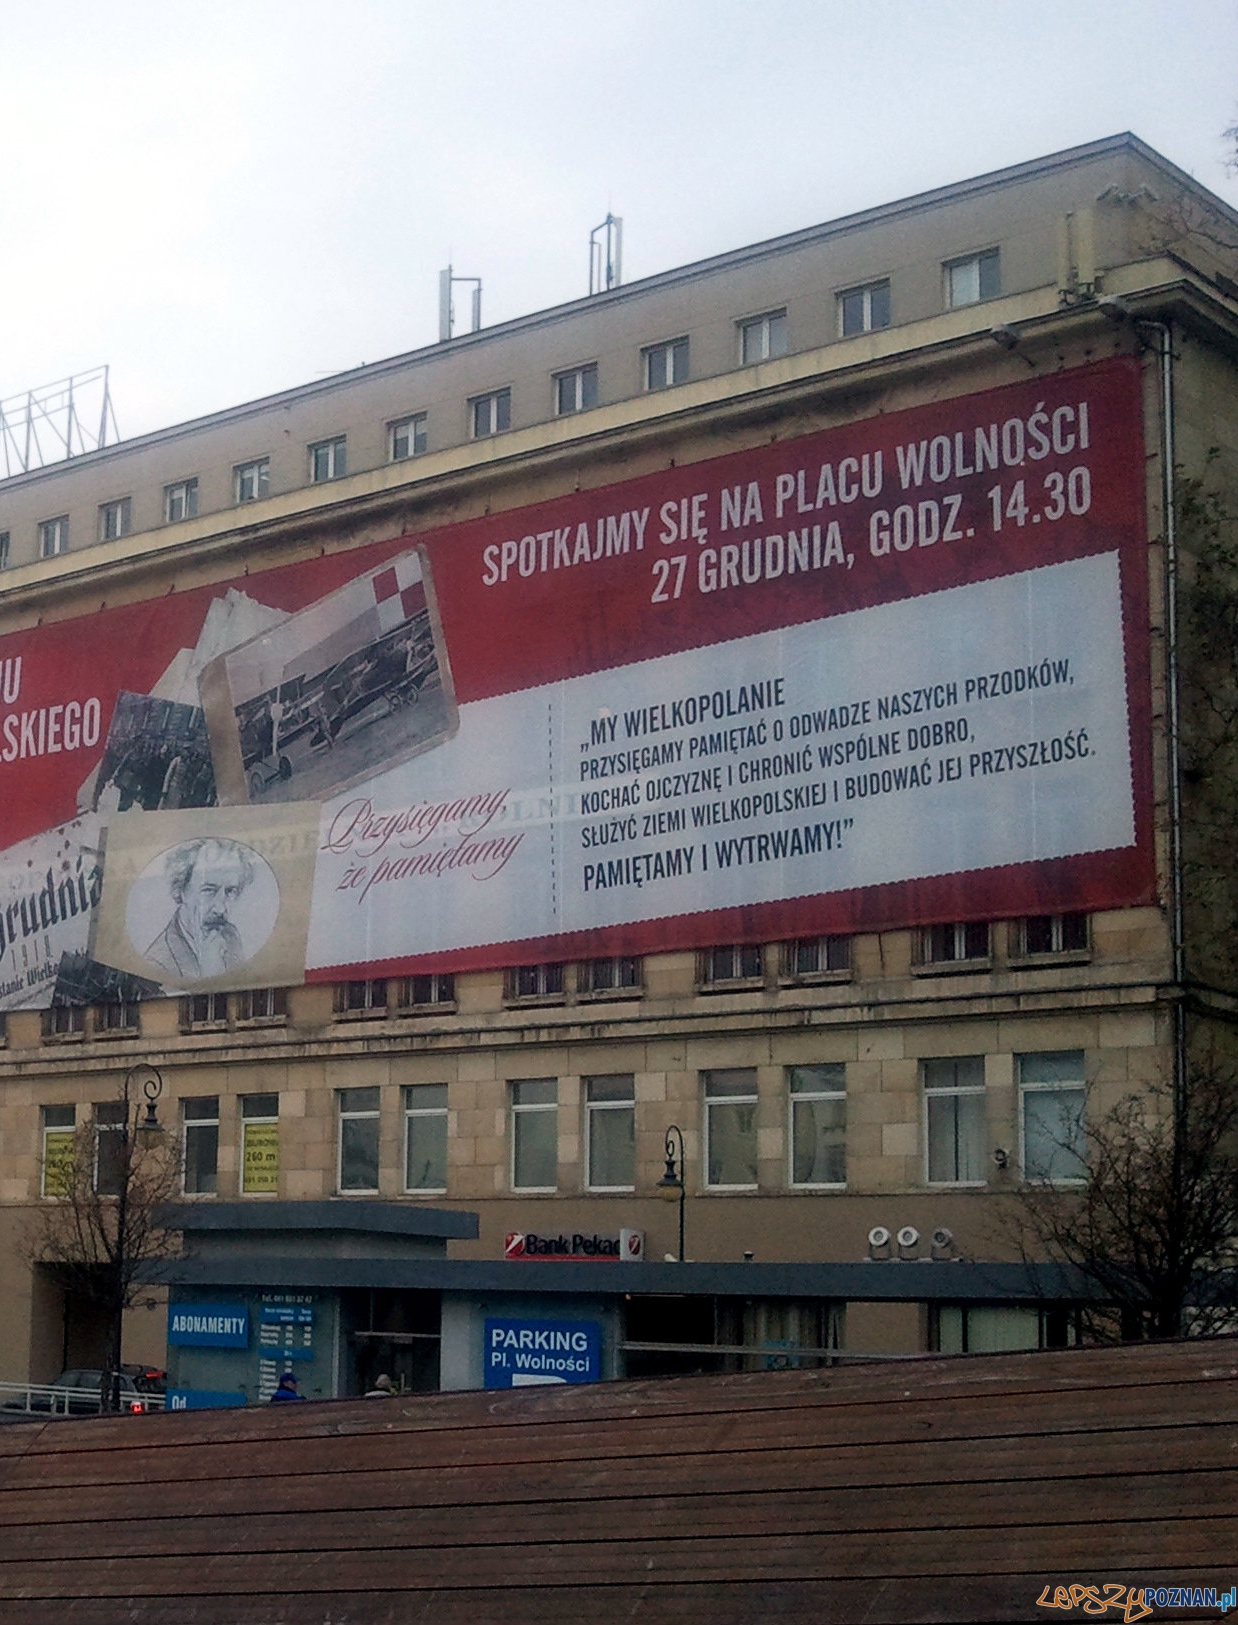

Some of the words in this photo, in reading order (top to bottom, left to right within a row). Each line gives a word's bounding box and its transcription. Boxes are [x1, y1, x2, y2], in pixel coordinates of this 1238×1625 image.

[482, 507, 650, 586] SPOTKAJMY
[659, 493, 708, 544] SIĘ
[720, 481, 763, 531] NA
[776, 451, 883, 518] PLACU
[896, 402, 1090, 490] WOLNOŚCI
[651, 555, 687, 603] 27
[698, 521, 855, 593] GRUDNIA,
[869, 494, 975, 556] GODZ.
[987, 466, 1092, 532] 14.30
[580, 740, 683, 781] PRZYSIĘGAMY
[689, 718, 767, 759] PAMIĘTAĆ
[773, 719, 783, 741] O
[790, 701, 871, 738] ODWADZE
[878, 682, 958, 721] NASZYCH
[965, 658, 1074, 703] PRZODKÓW,
[624, 678, 785, 738] WIELKOPOLANIE
[581, 778, 640, 815] KOCHAĆ
[646, 767, 722, 802] OJCZYZNĘ
[728, 765, 733, 787] I
[739, 744, 812, 785] CHRONIĆ
[818, 731, 900, 769] WSPÓLNE
[907, 718, 975, 751] DOBRO,
[581, 814, 637, 848] SŁUŻYĆ
[643, 809, 686, 837] ZIEMI
[691, 784, 827, 828] WIELKOPOLSKIEJ
[833, 780, 838, 802] I
[846, 757, 932, 800] BUDOWAĆ
[938, 757, 962, 783] JEJ
[969, 727, 1096, 777] PRZYSZŁOŚĆ.
[337, 861, 367, 891] że
[358, 833, 525, 905] pamiętamy
[584, 846, 695, 891] PAMIĘTAMY
[702, 844, 708, 871] I
[526, 1234, 570, 1255] Bank
[172, 1315, 245, 1334] ABONAMENTY
[492, 1329, 588, 1352] PARKING
[492, 1352, 511, 1368] Pl.
[515, 1353, 590, 1372] Wolności
